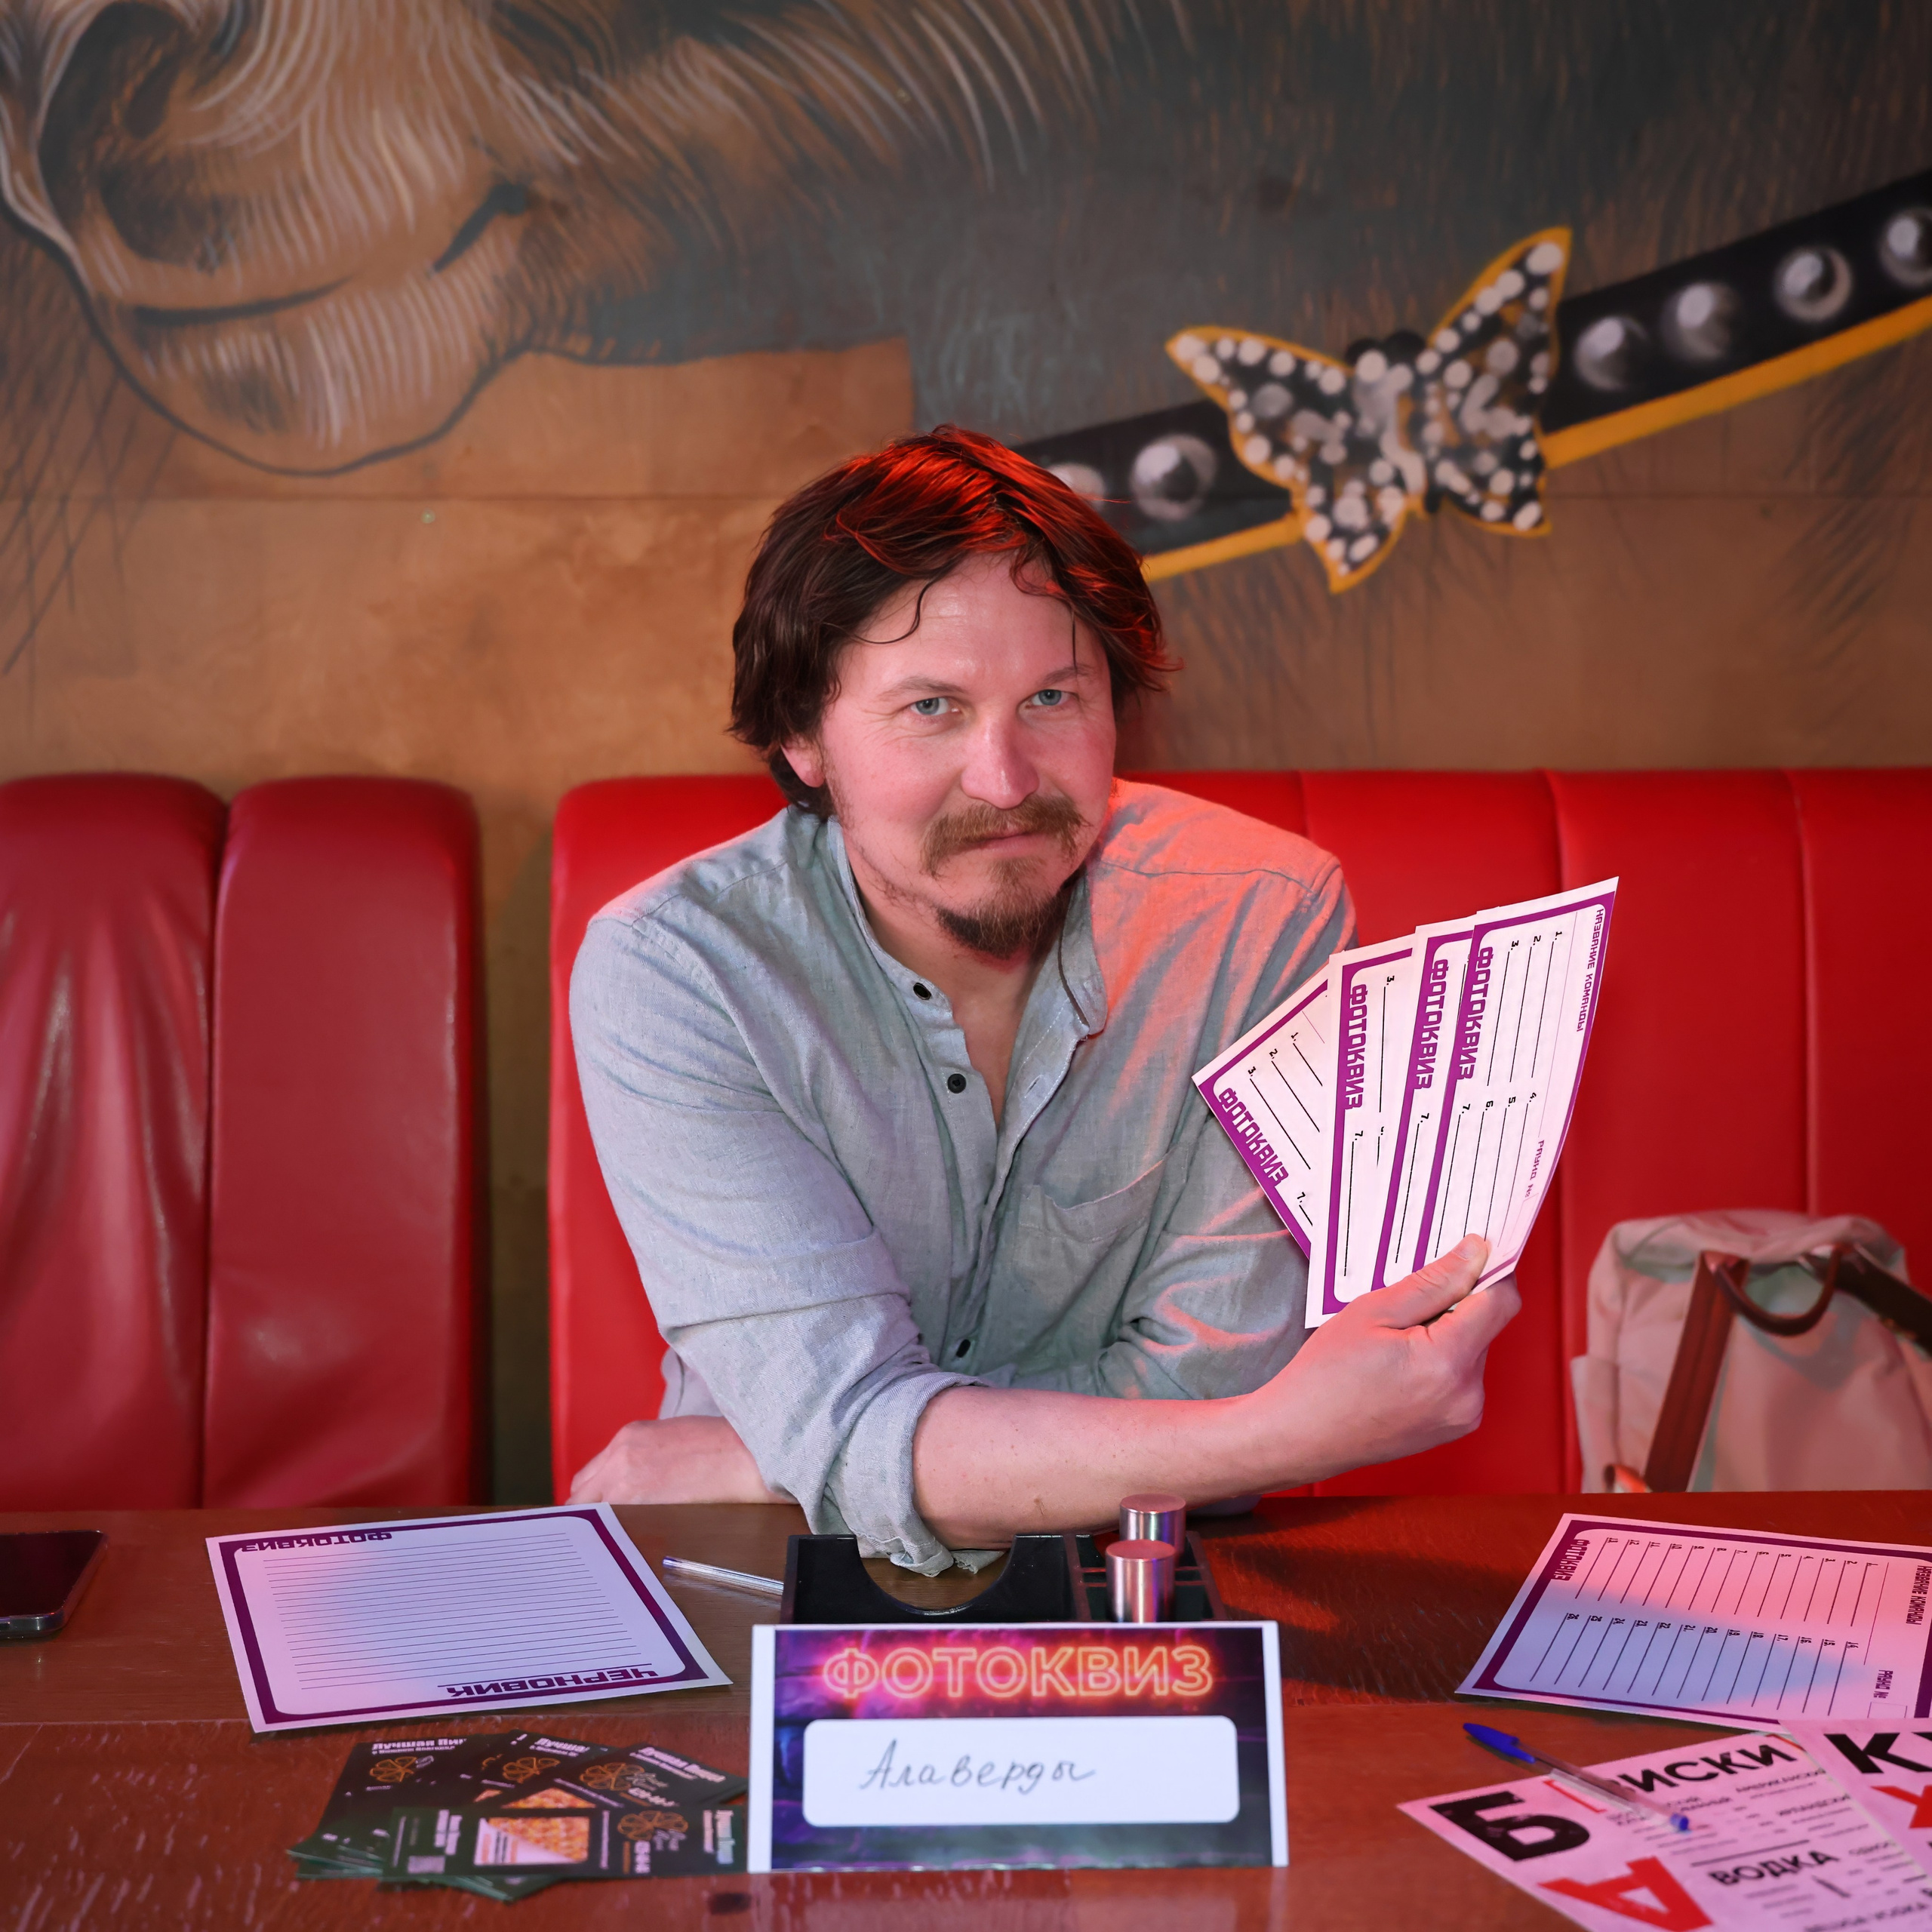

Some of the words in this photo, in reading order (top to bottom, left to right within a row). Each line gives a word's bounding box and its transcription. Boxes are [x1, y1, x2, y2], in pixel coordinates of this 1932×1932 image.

[1533, 935, 1541, 946] 2.
[1555, 931, 1563, 941] 1.
[1587, 908, 1604, 970] НАЗВАНИЕ
[1510, 940, 1519, 951] 3.
[1386, 975, 1395, 986] 3.
[1576, 973, 1595, 1032] КОМАНДЫ
[1457, 946, 1494, 1080] ФОТОКВИЗ
[1415, 958, 1449, 1089] ФОТОКВИЗ
[1290, 1032, 1299, 1042] 1.
[1269, 1048, 1278, 1060] 2.
[1346, 983, 1367, 1110] ФОТОКВИЗ
[1247, 1066, 1257, 1077] 3.
[1485, 1100, 1494, 1111] 6.
[1508, 1096, 1516, 1107] 5.
[1529, 1092, 1537, 1103] 4.
[1461, 1103, 1471, 1114] 7.
[1420, 1112, 1429, 1123] 7.
[1218, 1087, 1289, 1187] ФОТОКВИЗ
[1355, 1130, 1364, 1141] 7.
[1530, 1140, 1545, 1181] РАУНД
[1297, 1192, 1306, 1203] 7.
[241, 1532, 393, 1552] ФОТОКВИЗ
[823, 1645, 1214, 1699] ФОТОКВИЗ
[447, 1669, 659, 1697] ЧЕРНОВИК
[859, 1738, 1097, 1795] Алаверды
[1603, 1744, 1798, 1795] ИСКИ
[1428, 1791, 1591, 1862] Б
[1707, 1849, 1841, 1886] ВОДКА
